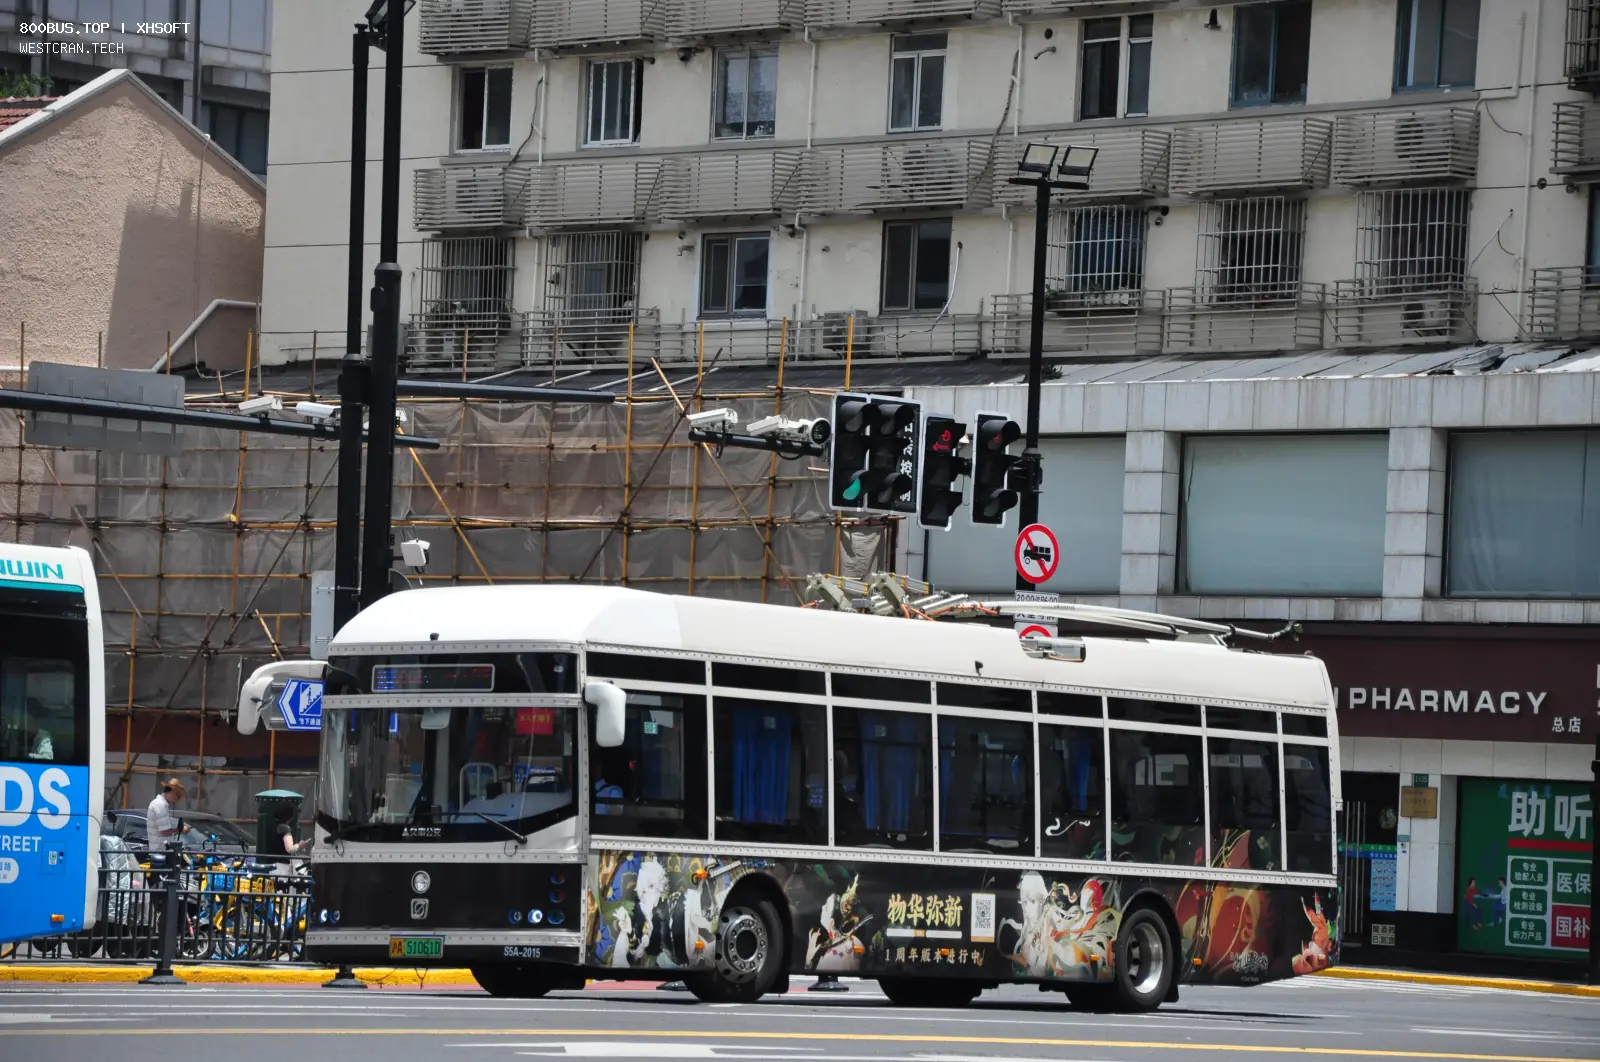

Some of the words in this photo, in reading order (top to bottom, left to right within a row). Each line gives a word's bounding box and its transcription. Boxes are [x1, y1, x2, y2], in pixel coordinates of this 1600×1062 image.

[0, 559, 63, 579] WIN
[1349, 687, 1547, 715] PHARMACY
[1552, 716, 1582, 734] 总店
[1522, 862, 1537, 872] 专业
[1514, 872, 1544, 883] 验配人员
[1557, 872, 1591, 894] 医保
[1521, 892, 1536, 901] 专业
[887, 893, 963, 927] 物华弥新
[1513, 901, 1543, 912] 检测设备
[1521, 921, 1536, 930] 专业
[1556, 916, 1591, 939] 国补
[1513, 930, 1543, 941] 听力产品
[503, 946, 541, 959] S5A-2015
